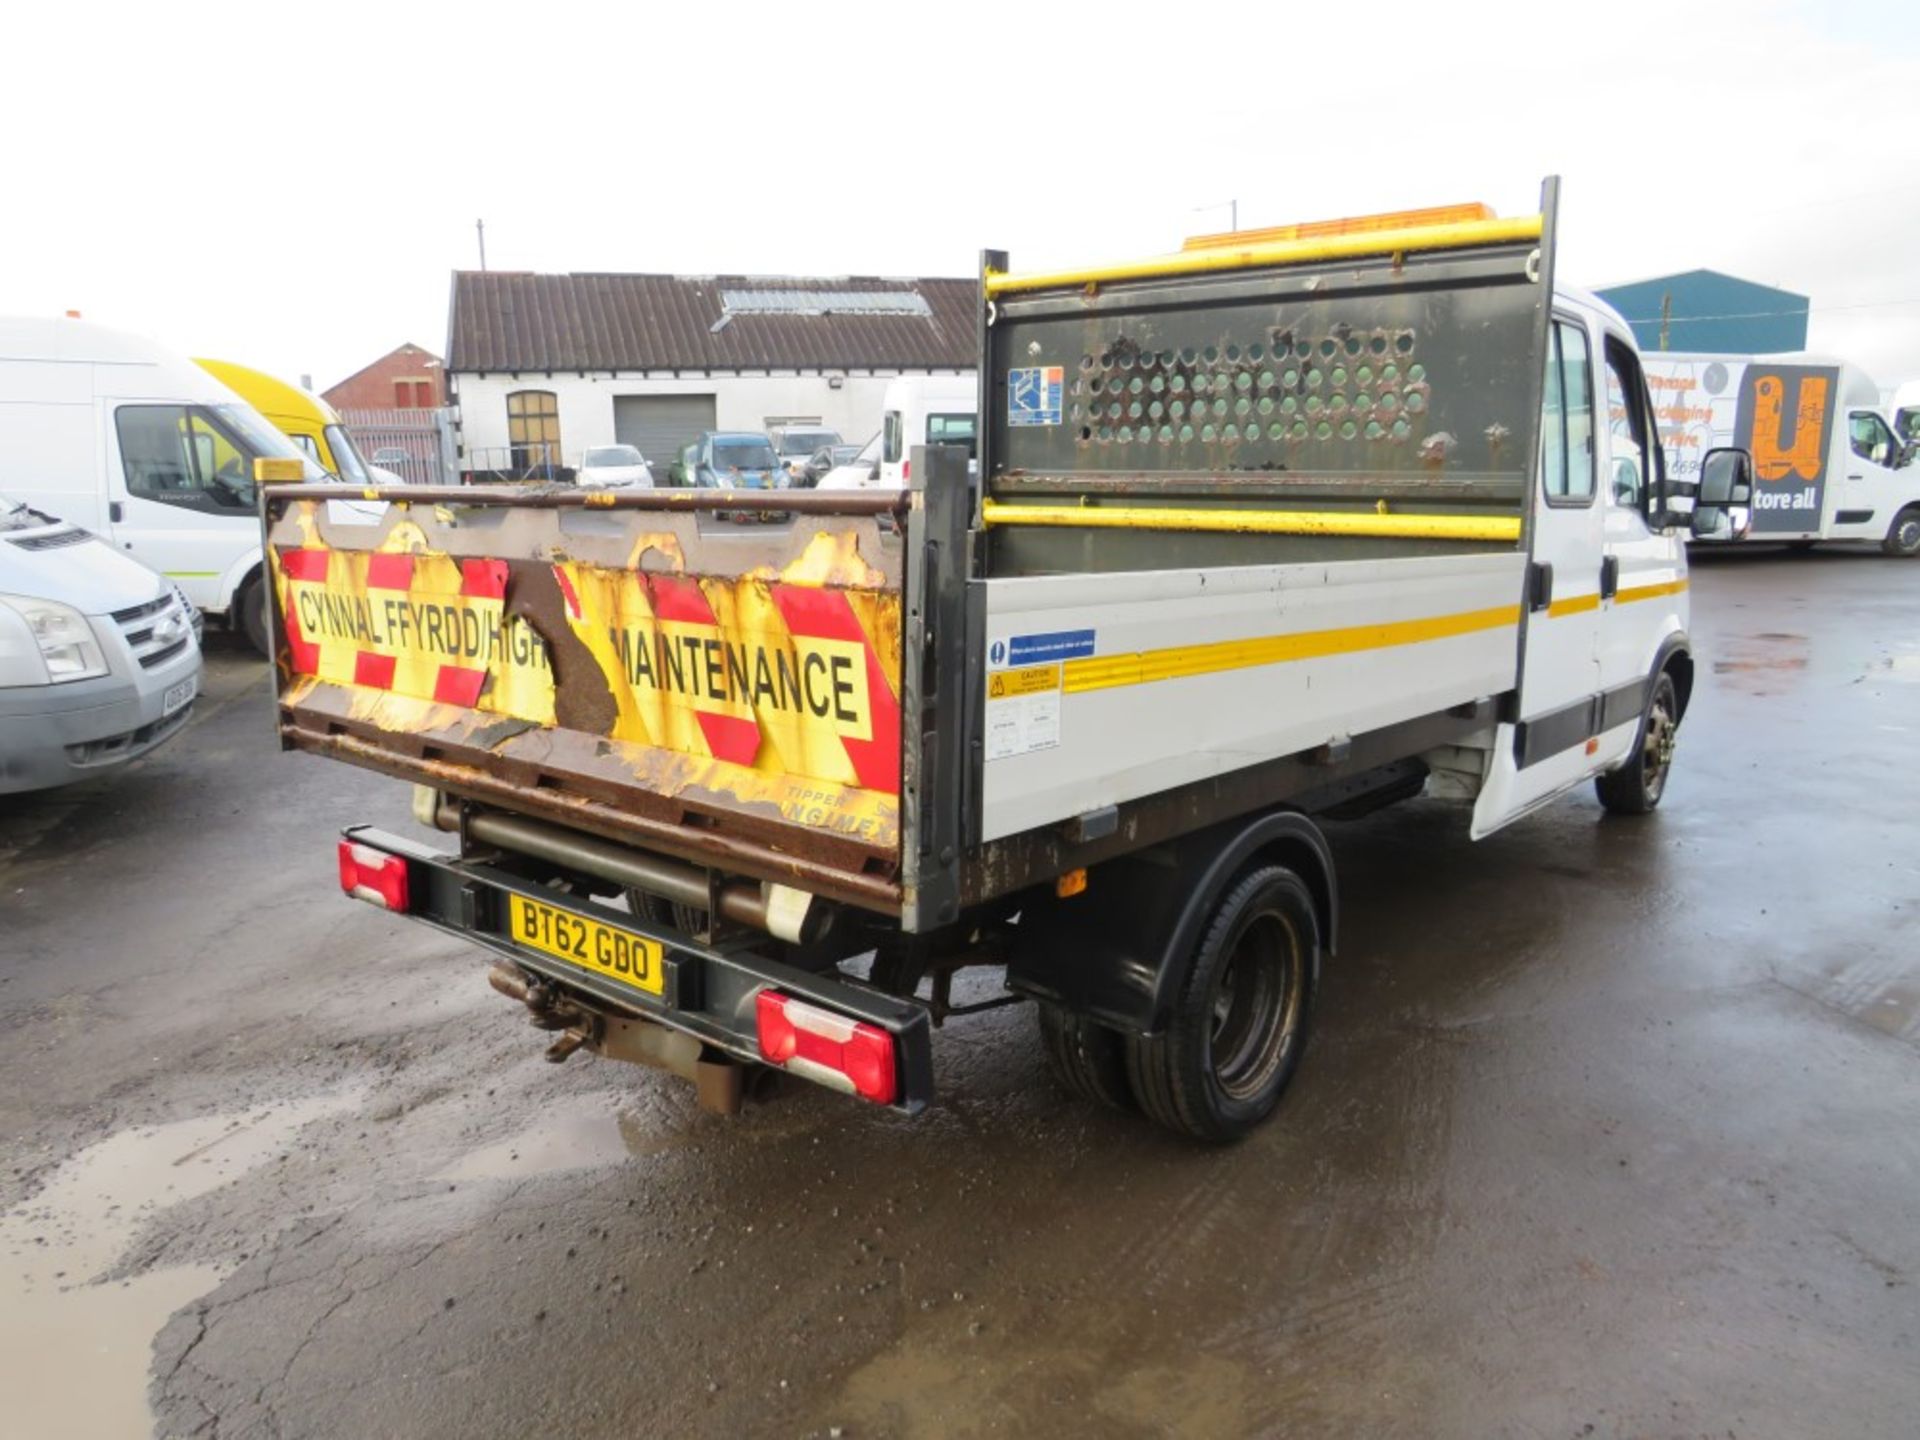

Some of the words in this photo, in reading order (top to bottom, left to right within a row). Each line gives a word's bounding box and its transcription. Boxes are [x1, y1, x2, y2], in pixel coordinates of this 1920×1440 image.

[1754, 488, 1791, 510] tore
[1792, 487, 1816, 510] all
[300, 590, 382, 644] CYNNAL
[610, 627, 858, 722] MAINTENANCE
[523, 901, 588, 960] BT62
[596, 927, 648, 980] GDO
